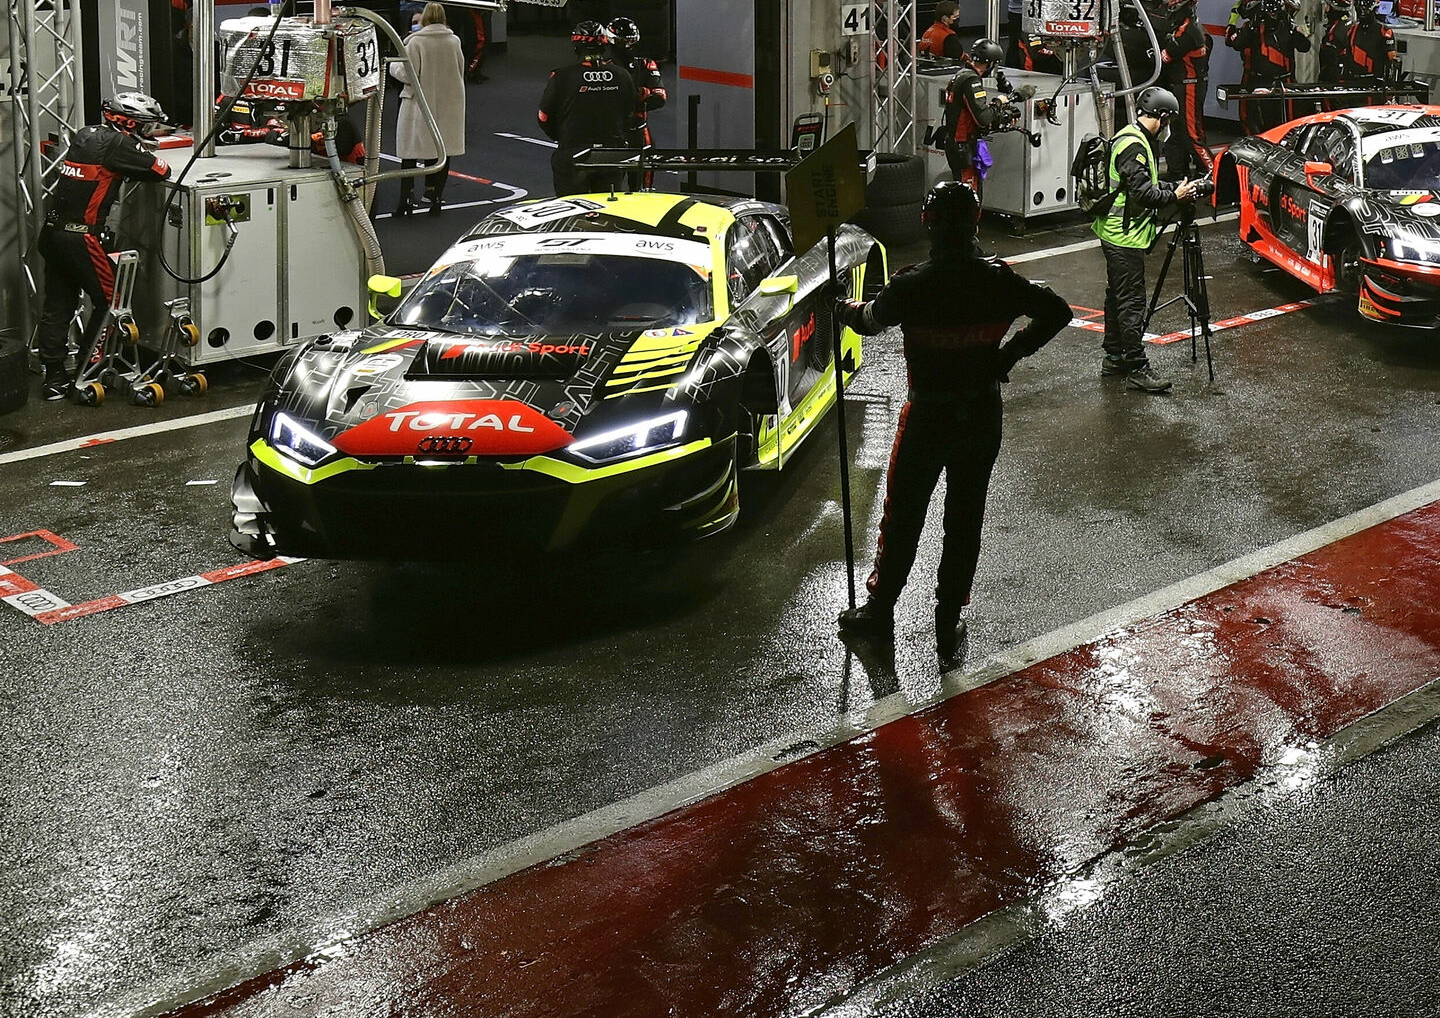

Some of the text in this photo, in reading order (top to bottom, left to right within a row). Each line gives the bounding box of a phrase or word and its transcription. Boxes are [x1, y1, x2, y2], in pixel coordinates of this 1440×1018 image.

[844, 8, 870, 32] 41
[1048, 22, 1086, 32] TOTAL
[257, 39, 292, 78] 31
[357, 38, 378, 78] 32
[248, 82, 299, 96] TOTAL
[1378, 110, 1407, 121] 31
[811, 170, 827, 218] START
[823, 164, 839, 218] ENGINE
[524, 202, 577, 219] 30
[1287, 196, 1307, 223] Sport
[1311, 219, 1321, 251] 31
[467, 240, 504, 253] aws
[635, 239, 675, 252] aws
[394, 330, 430, 340] PRO
[527, 342, 589, 357] Sport
[385, 411, 535, 433] TOTAL
